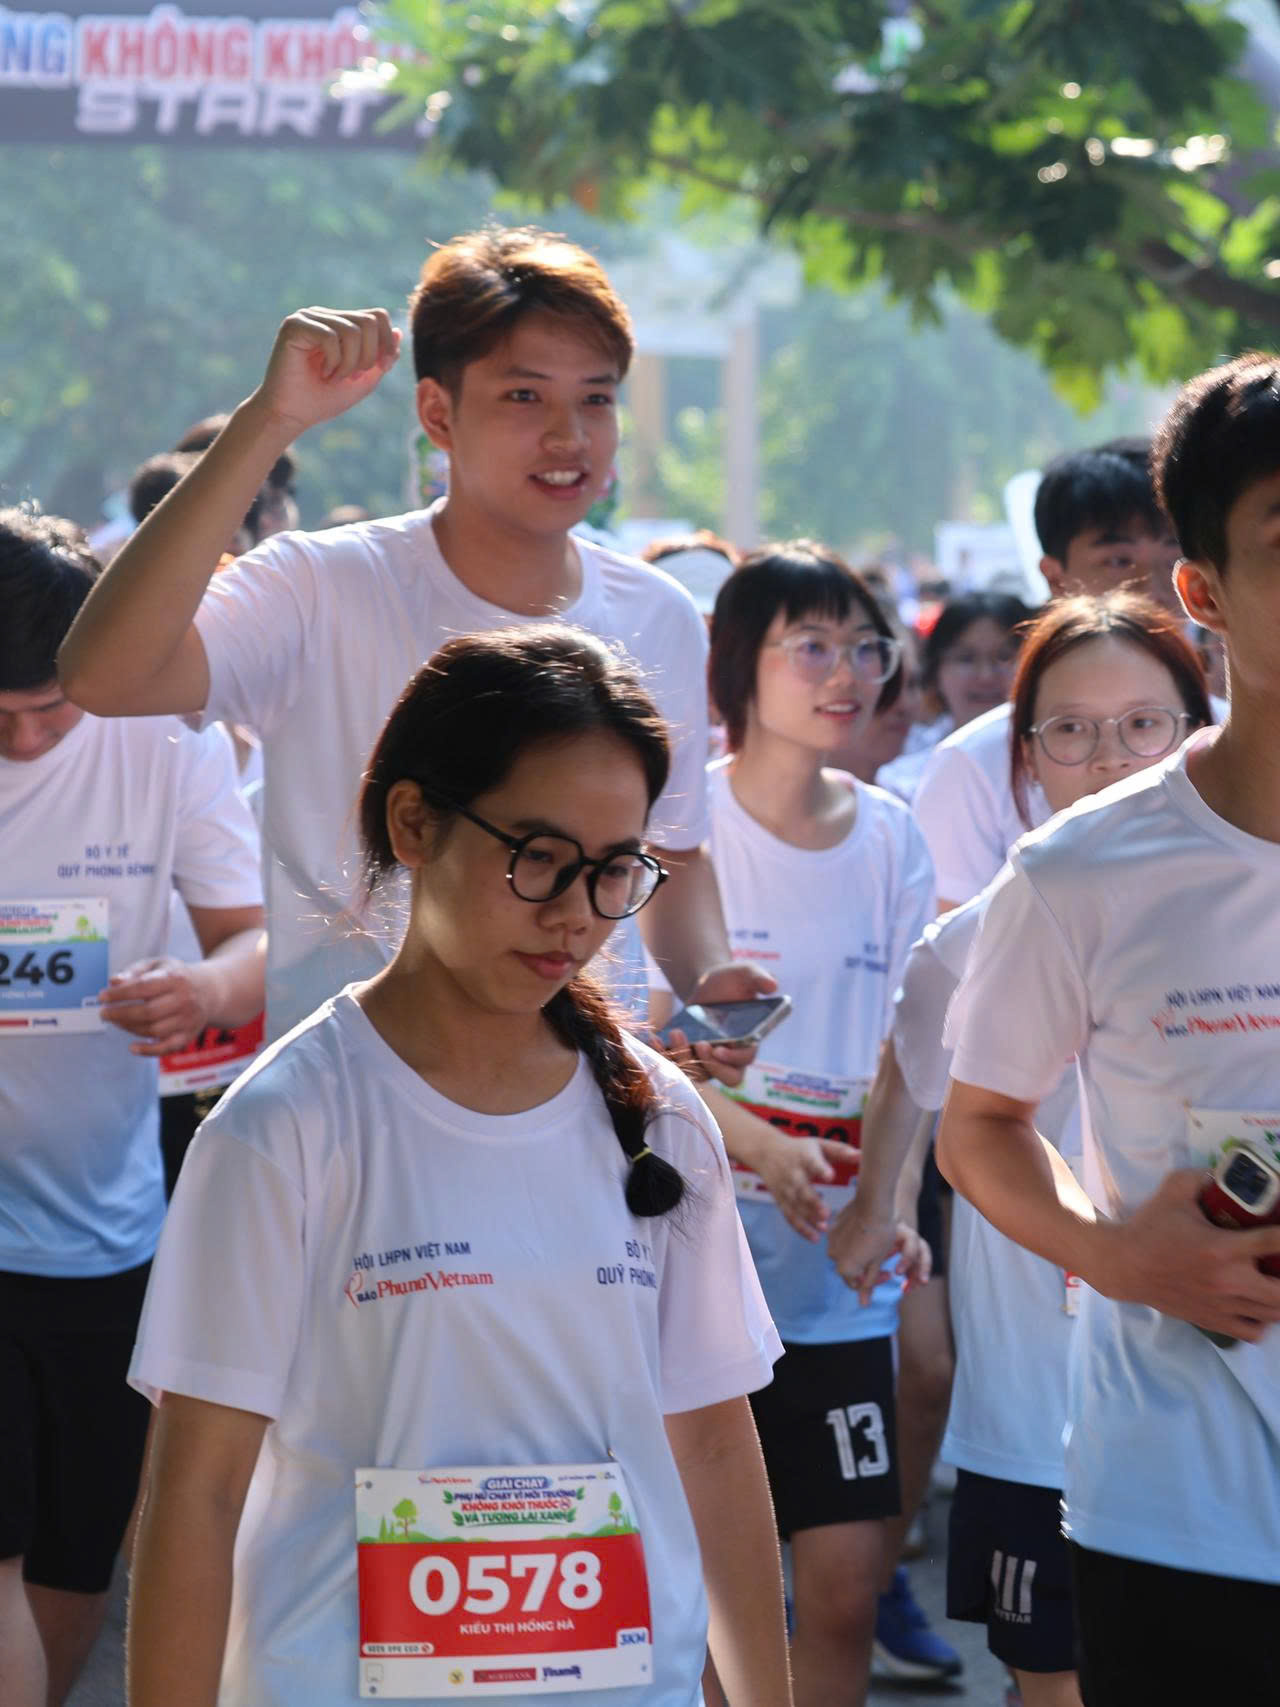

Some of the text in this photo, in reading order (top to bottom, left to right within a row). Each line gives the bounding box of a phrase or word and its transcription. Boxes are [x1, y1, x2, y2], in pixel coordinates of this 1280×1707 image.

[76, 83, 386, 136] START
[378, 1248, 412, 1267] LHPN
[444, 1241, 472, 1256] NAM
[825, 1401, 890, 1480] 13
[409, 1550, 602, 1616] 0578
